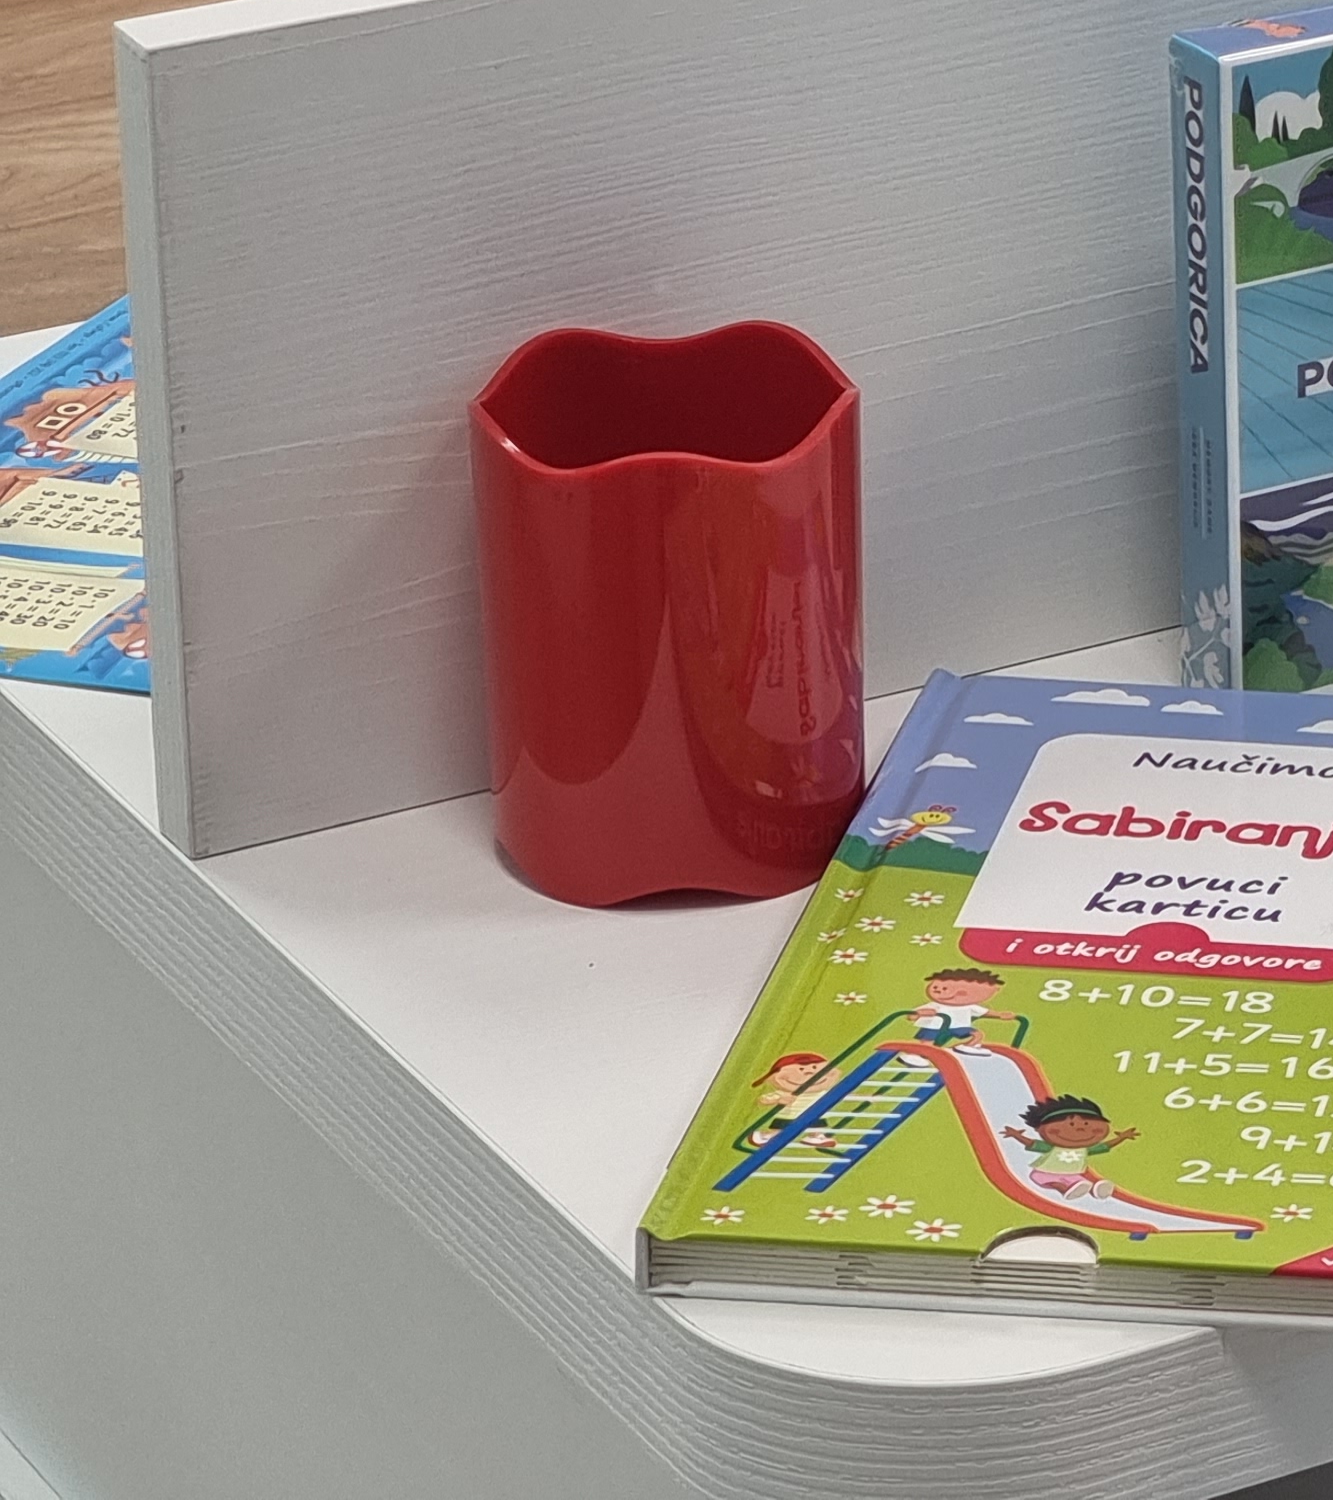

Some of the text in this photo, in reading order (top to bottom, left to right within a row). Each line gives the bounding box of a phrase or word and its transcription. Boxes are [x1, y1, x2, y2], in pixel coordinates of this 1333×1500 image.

[1184, 75, 1208, 374] PODGORICA
[1106, 869, 1286, 901] povuci
[1084, 893, 1283, 925] karticu
[1006, 937, 1323, 975] i otkrij odgovore
[1038, 979, 1274, 1014] 8+10=18
